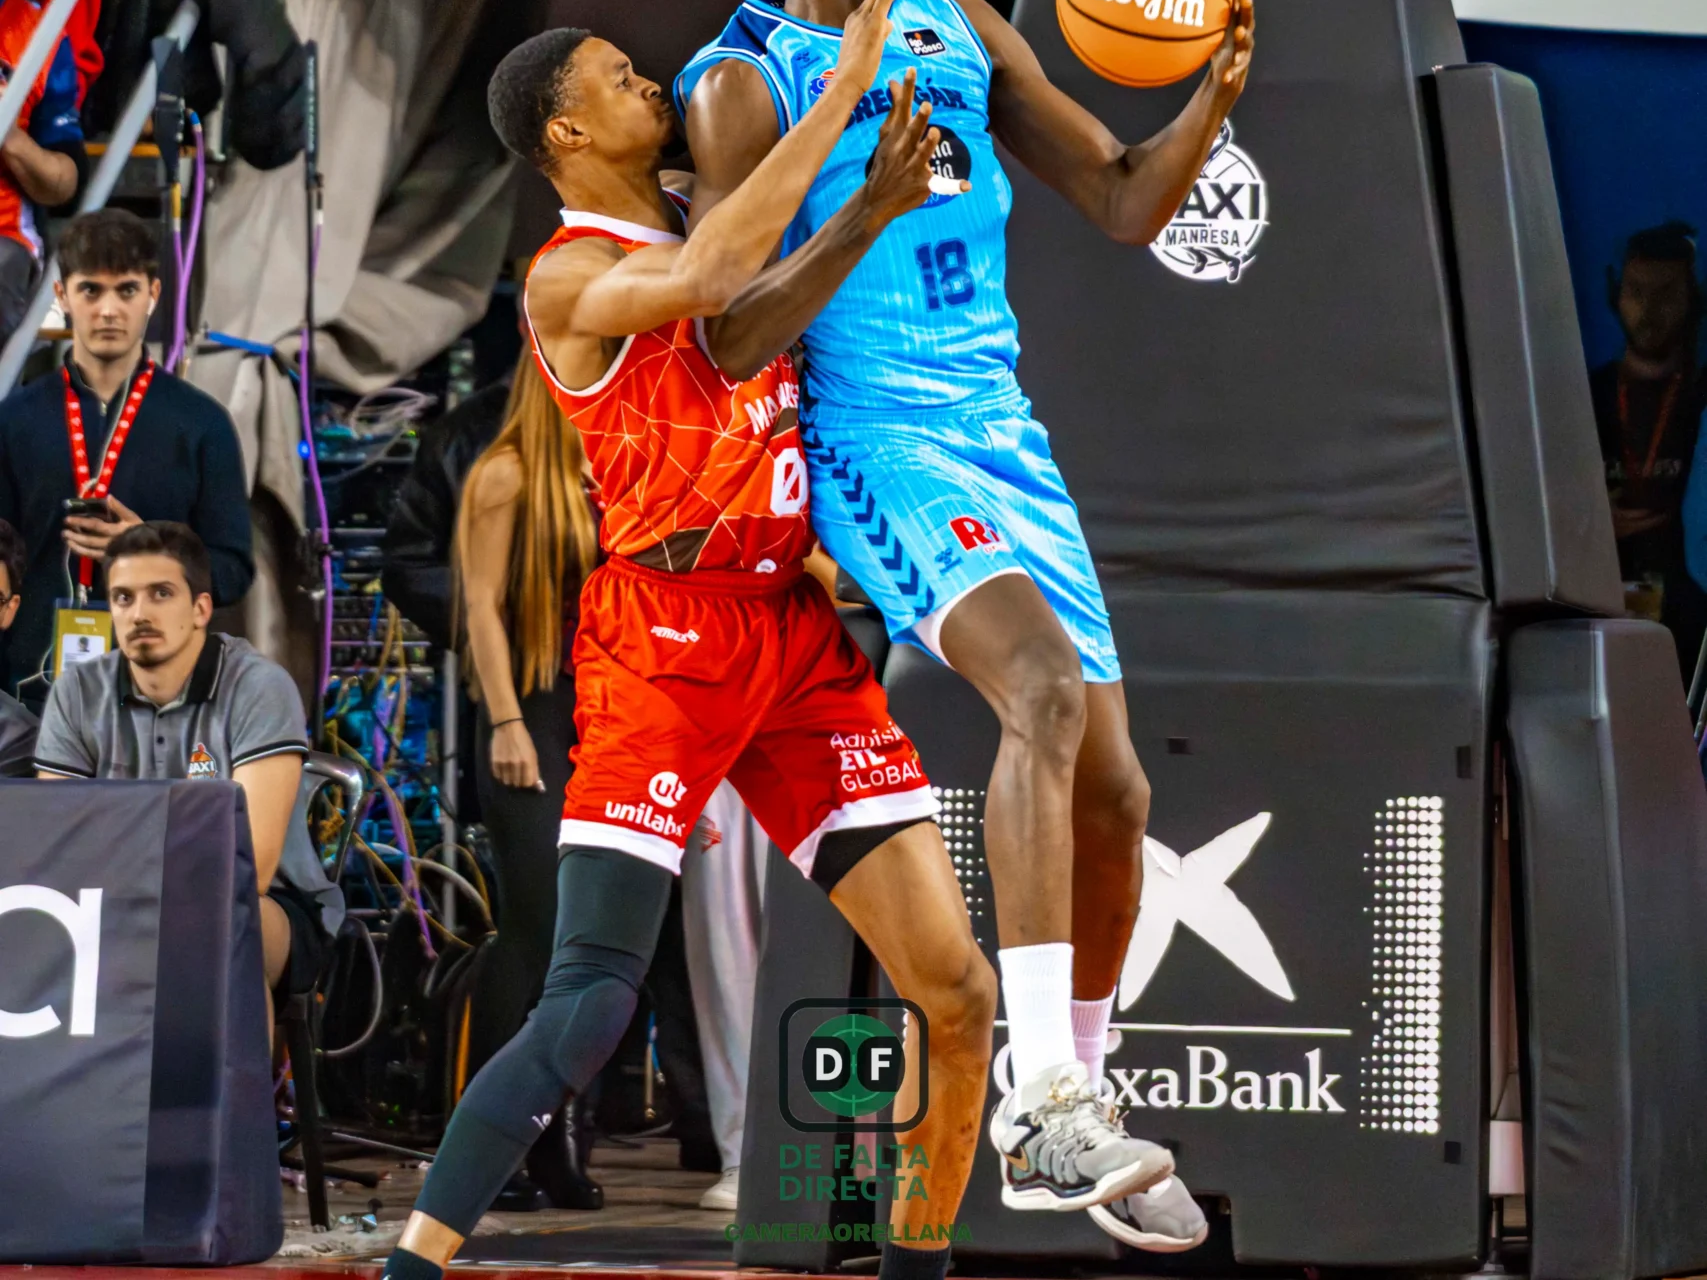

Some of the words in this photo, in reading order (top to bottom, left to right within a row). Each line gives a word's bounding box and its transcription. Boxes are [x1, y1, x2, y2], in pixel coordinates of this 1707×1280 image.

[1174, 183, 1260, 220] AXI
[1165, 228, 1240, 247] MANRESA
[914, 237, 976, 312] 18
[841, 760, 922, 792] GLOBAL
[993, 1034, 1346, 1112] xaBank
